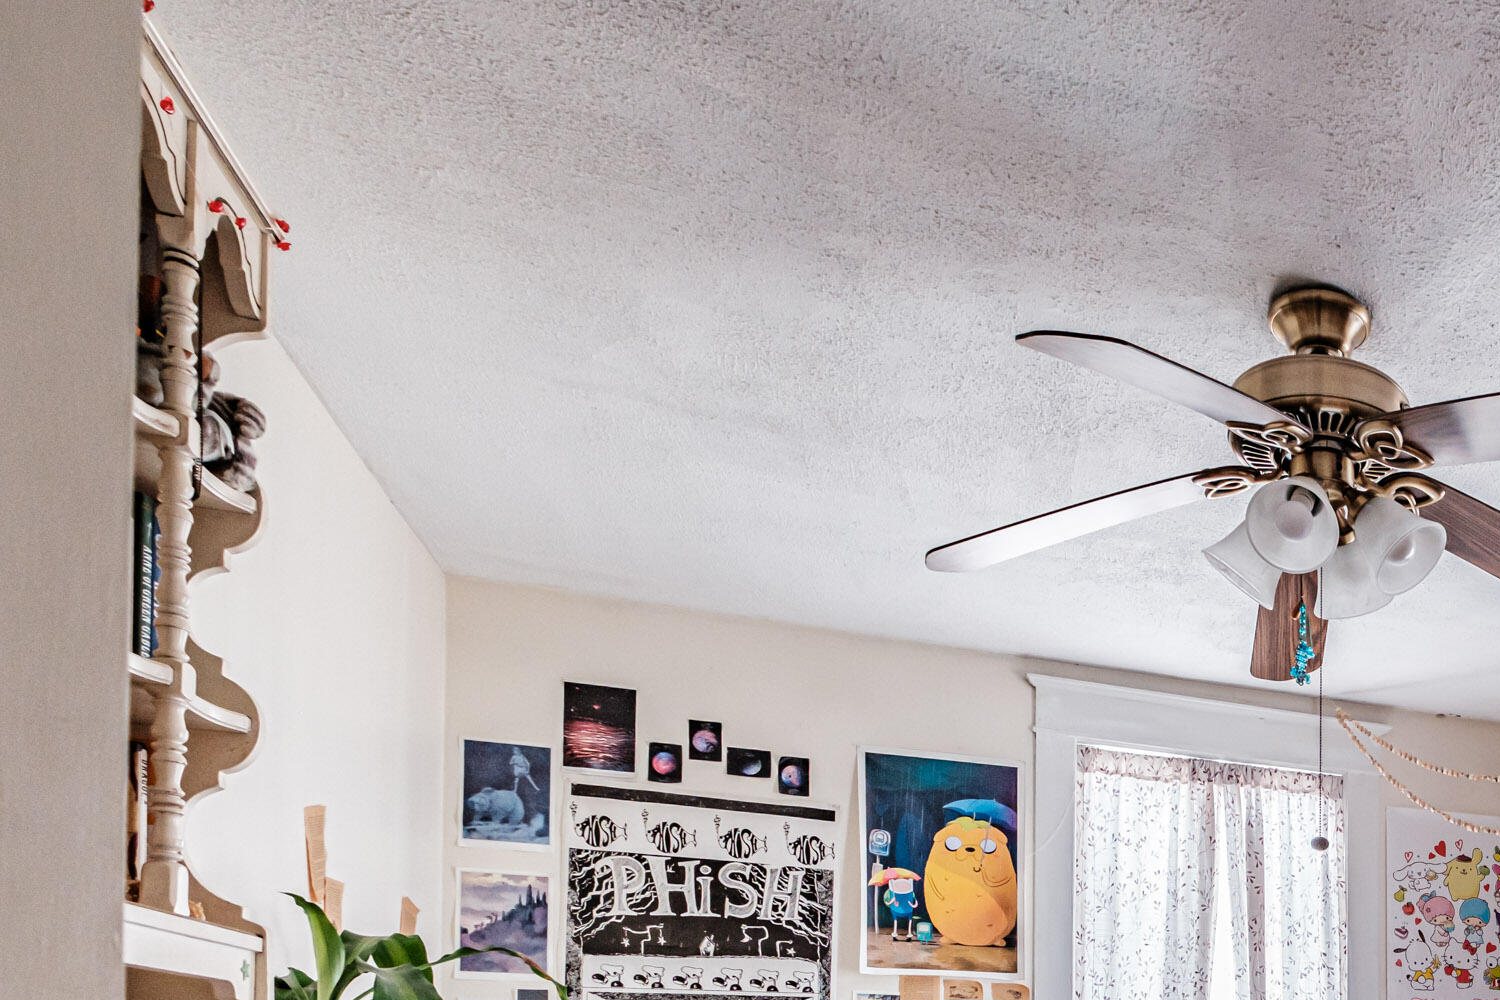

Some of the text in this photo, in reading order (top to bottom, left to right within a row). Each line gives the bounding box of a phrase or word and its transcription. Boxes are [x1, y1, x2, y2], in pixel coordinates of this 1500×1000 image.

[140, 544, 152, 659] ANNE OF GREEN GABLE
[594, 855, 806, 921] PHiSH
